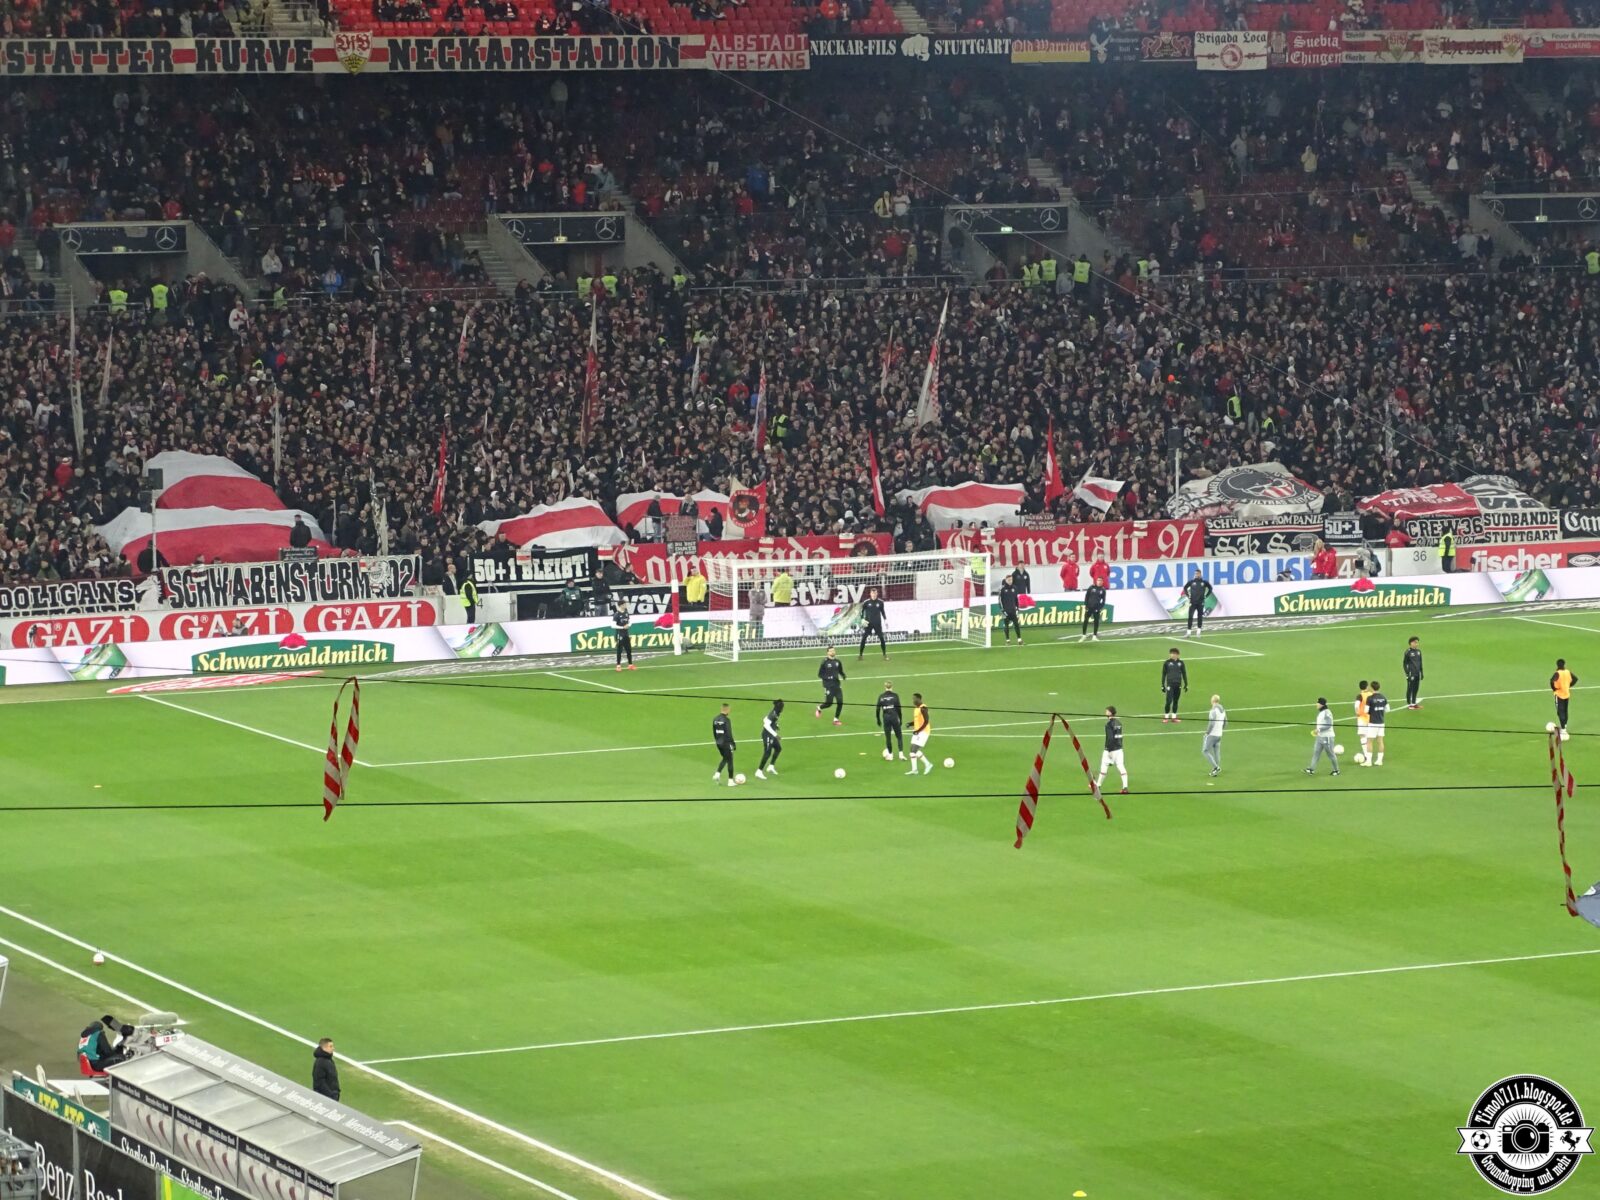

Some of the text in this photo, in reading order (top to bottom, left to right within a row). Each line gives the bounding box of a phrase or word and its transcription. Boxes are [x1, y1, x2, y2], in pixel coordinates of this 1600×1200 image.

[709, 33, 809, 51] ALBSTADT
[810, 39, 896, 56] NECKAR-FILS
[934, 38, 1011, 55] STUTTGART
[1012, 38, 1088, 53] Old Warriors
[1196, 32, 1267, 46] Brigada Loca
[1293, 35, 1340, 49] Suebia
[6, 38, 313, 74] STATTER KURVE
[387, 36, 681, 72] NECKARSTADION
[711, 52, 806, 70] VFB-FANS
[1290, 51, 1342, 65] Ehingen
[1325, 520, 1363, 534] 50+1
[1408, 517, 1483, 538] CREW 36
[1157, 523, 1199, 559] 97
[1485, 530, 1558, 543] STUTTGART
[1413, 550, 1427, 562] 36
[1472, 548, 1562, 572] fischer
[522, 552, 590, 580] BLEIBT!
[168, 559, 414, 608] SCHWABENSTURM 02
[940, 573, 954, 585] 35
[1279, 587, 1446, 614] Schwarzwaldmilch
[198, 643, 389, 672] Schwarzwaldmilch
